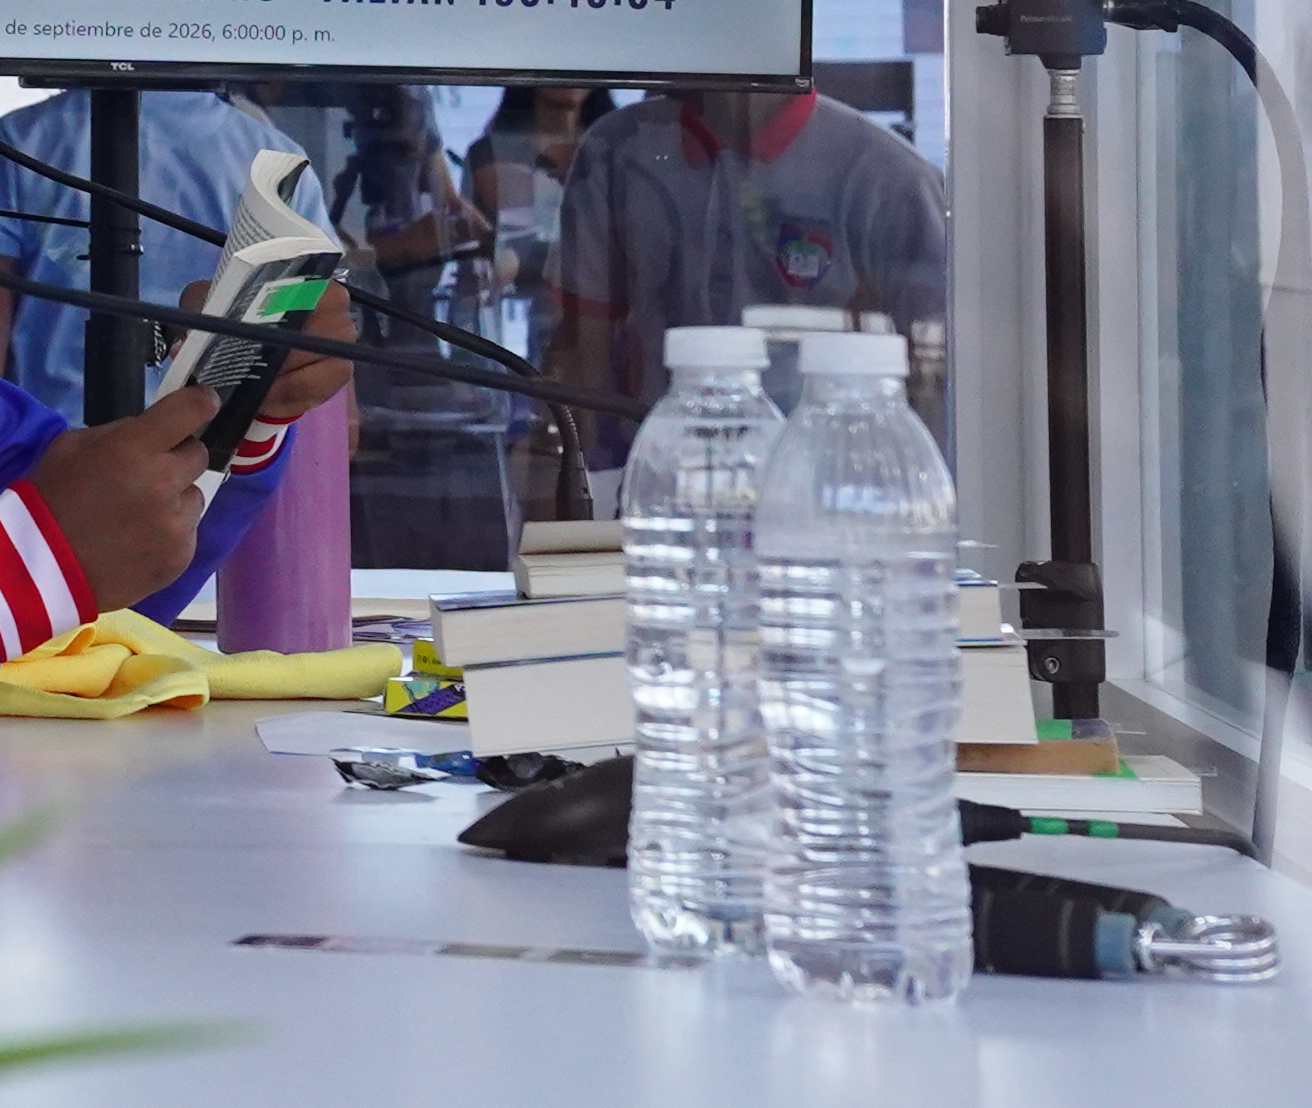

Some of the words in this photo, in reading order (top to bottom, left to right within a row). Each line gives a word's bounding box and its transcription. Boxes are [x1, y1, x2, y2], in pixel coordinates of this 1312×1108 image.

[5, 18, 28, 36] de
[33, 20, 134, 41] septiembre
[140, 21, 162, 38] de
[168, 22, 216, 42] 2026,
[222, 24, 286, 41] 6:00:00
[292, 28, 308, 45] p.
[314, 28, 336, 42] m.
[110, 62, 135, 71] TCL
